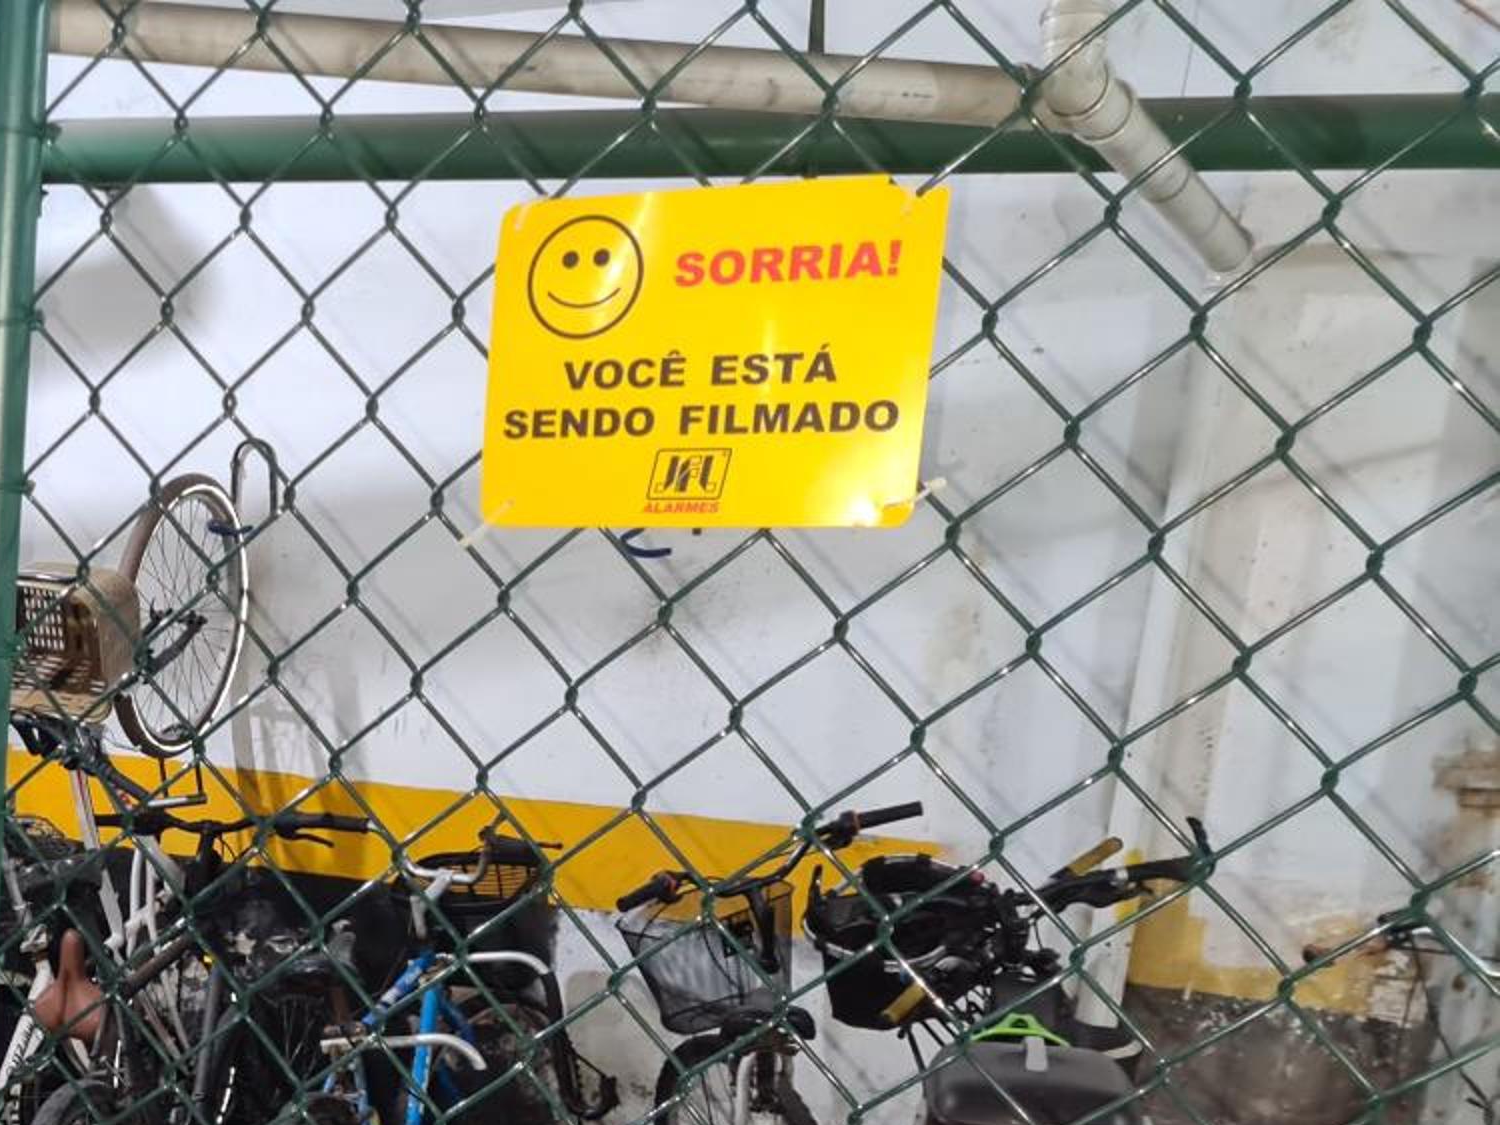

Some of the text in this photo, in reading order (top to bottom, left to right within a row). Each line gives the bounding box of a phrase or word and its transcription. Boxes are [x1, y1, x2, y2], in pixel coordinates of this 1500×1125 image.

[675, 240, 902, 288] SORRIA!
[564, 344, 837, 391] VOCÊ ESTÁ
[503, 400, 899, 440] SENDO FILMADO
[643, 501, 719, 513] ALARMES
